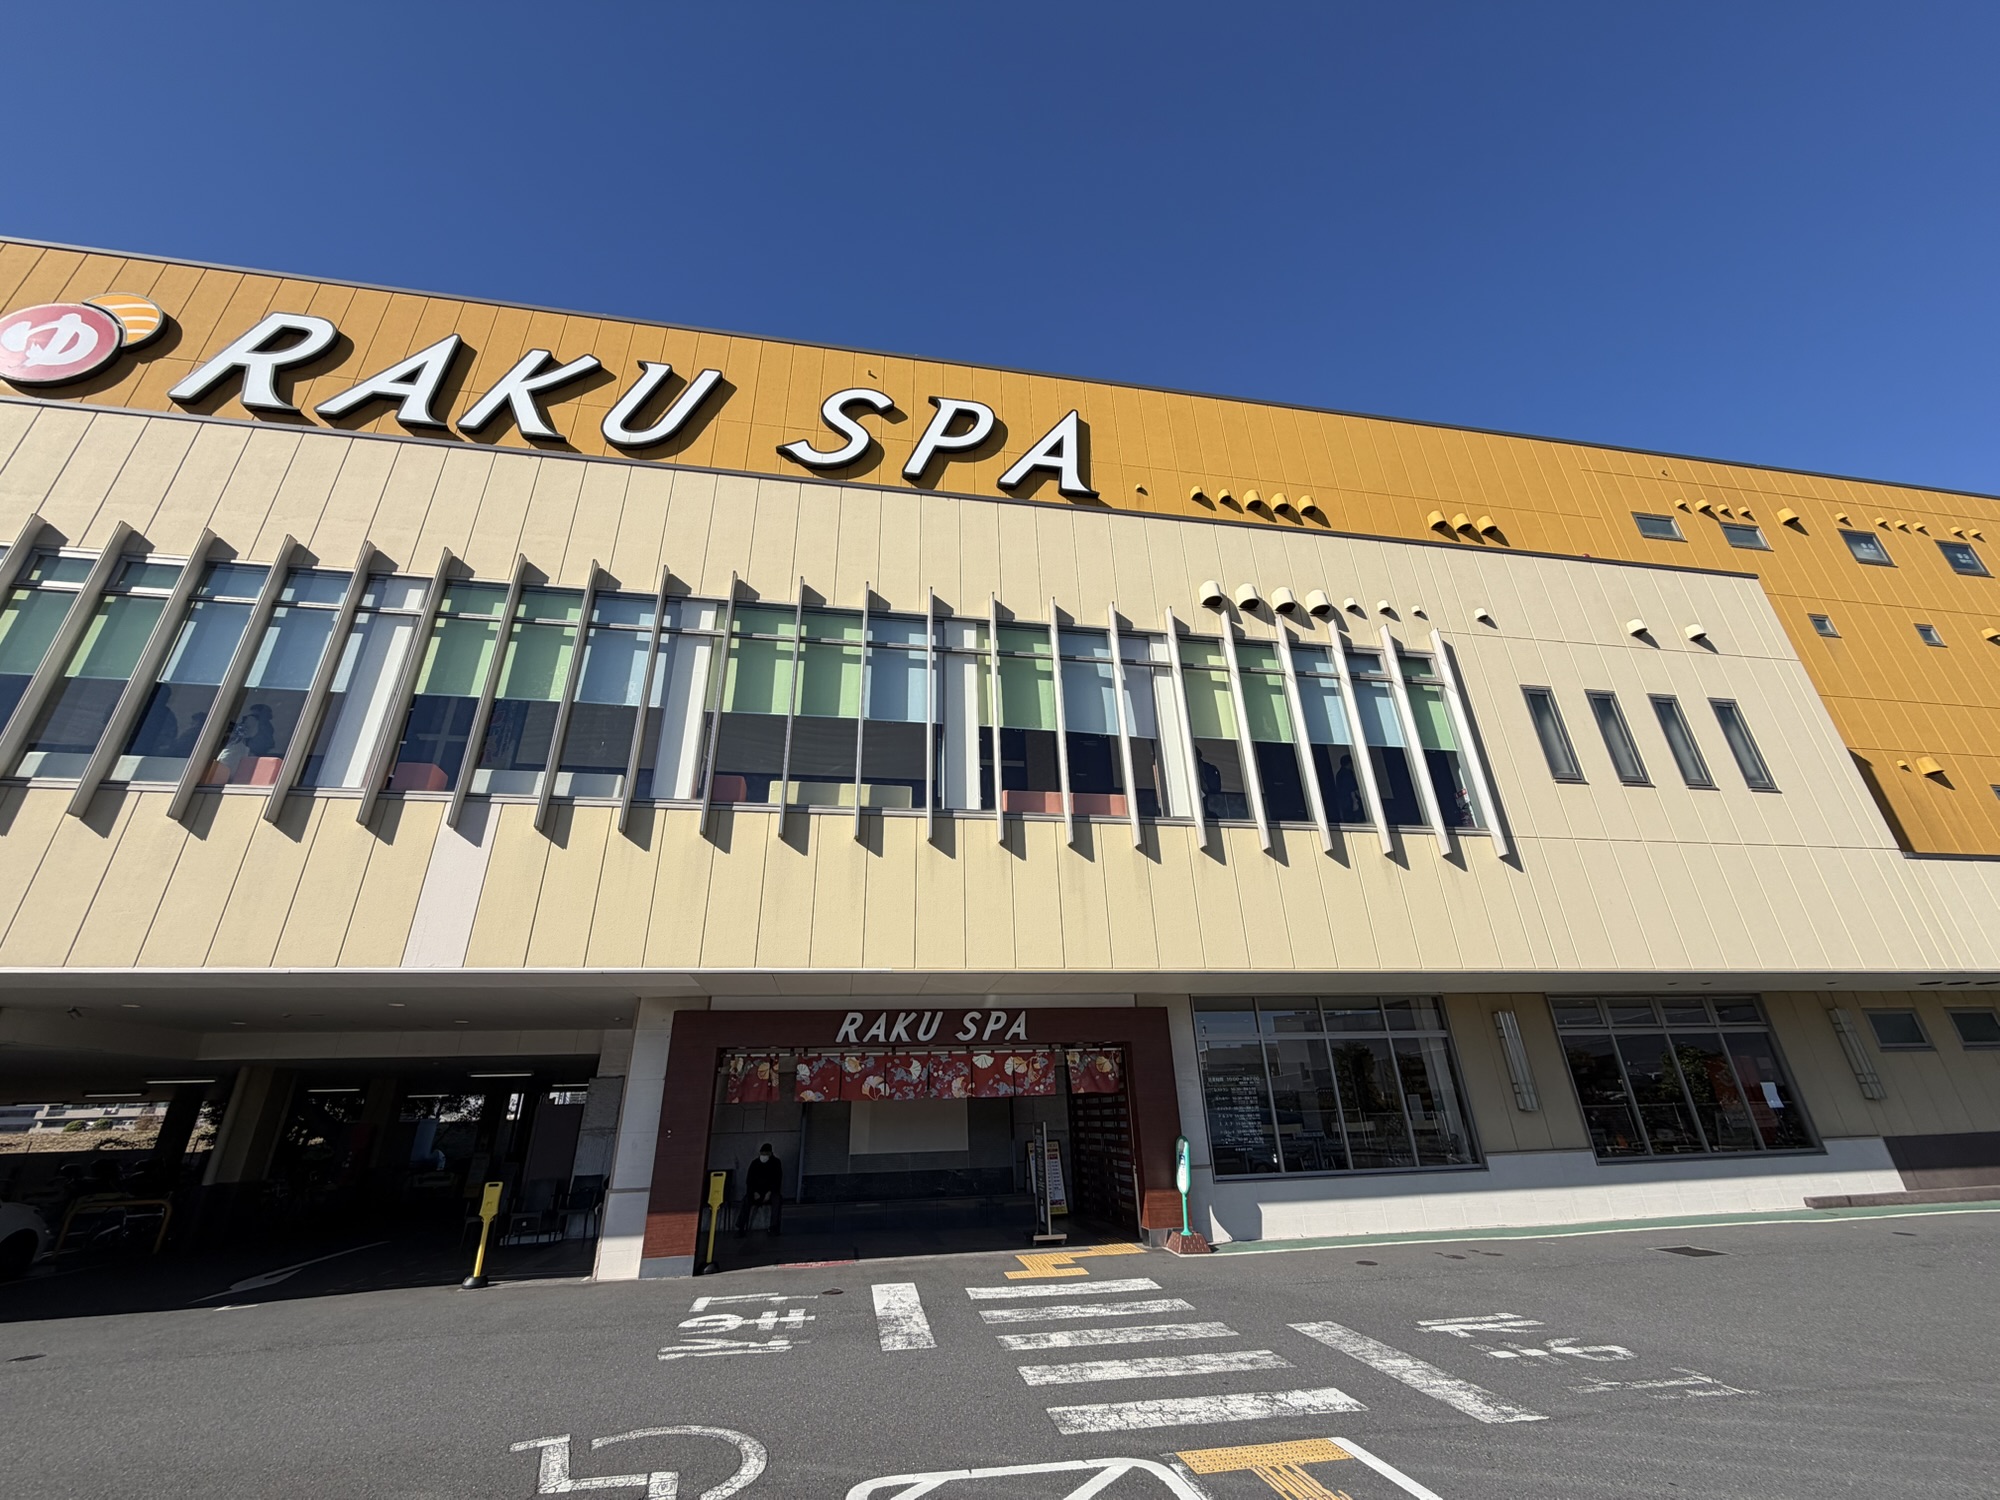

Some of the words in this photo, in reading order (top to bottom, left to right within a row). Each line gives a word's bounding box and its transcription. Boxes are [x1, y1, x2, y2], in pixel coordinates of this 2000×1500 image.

[1, 313, 99, 368] ゆ
[167, 312, 723, 451] RAKU
[776, 388, 1100, 499] SPA
[835, 1011, 944, 1043] RAKU
[955, 1010, 1029, 1041] SPA
[656, 1292, 818, 1361] 止まれ
